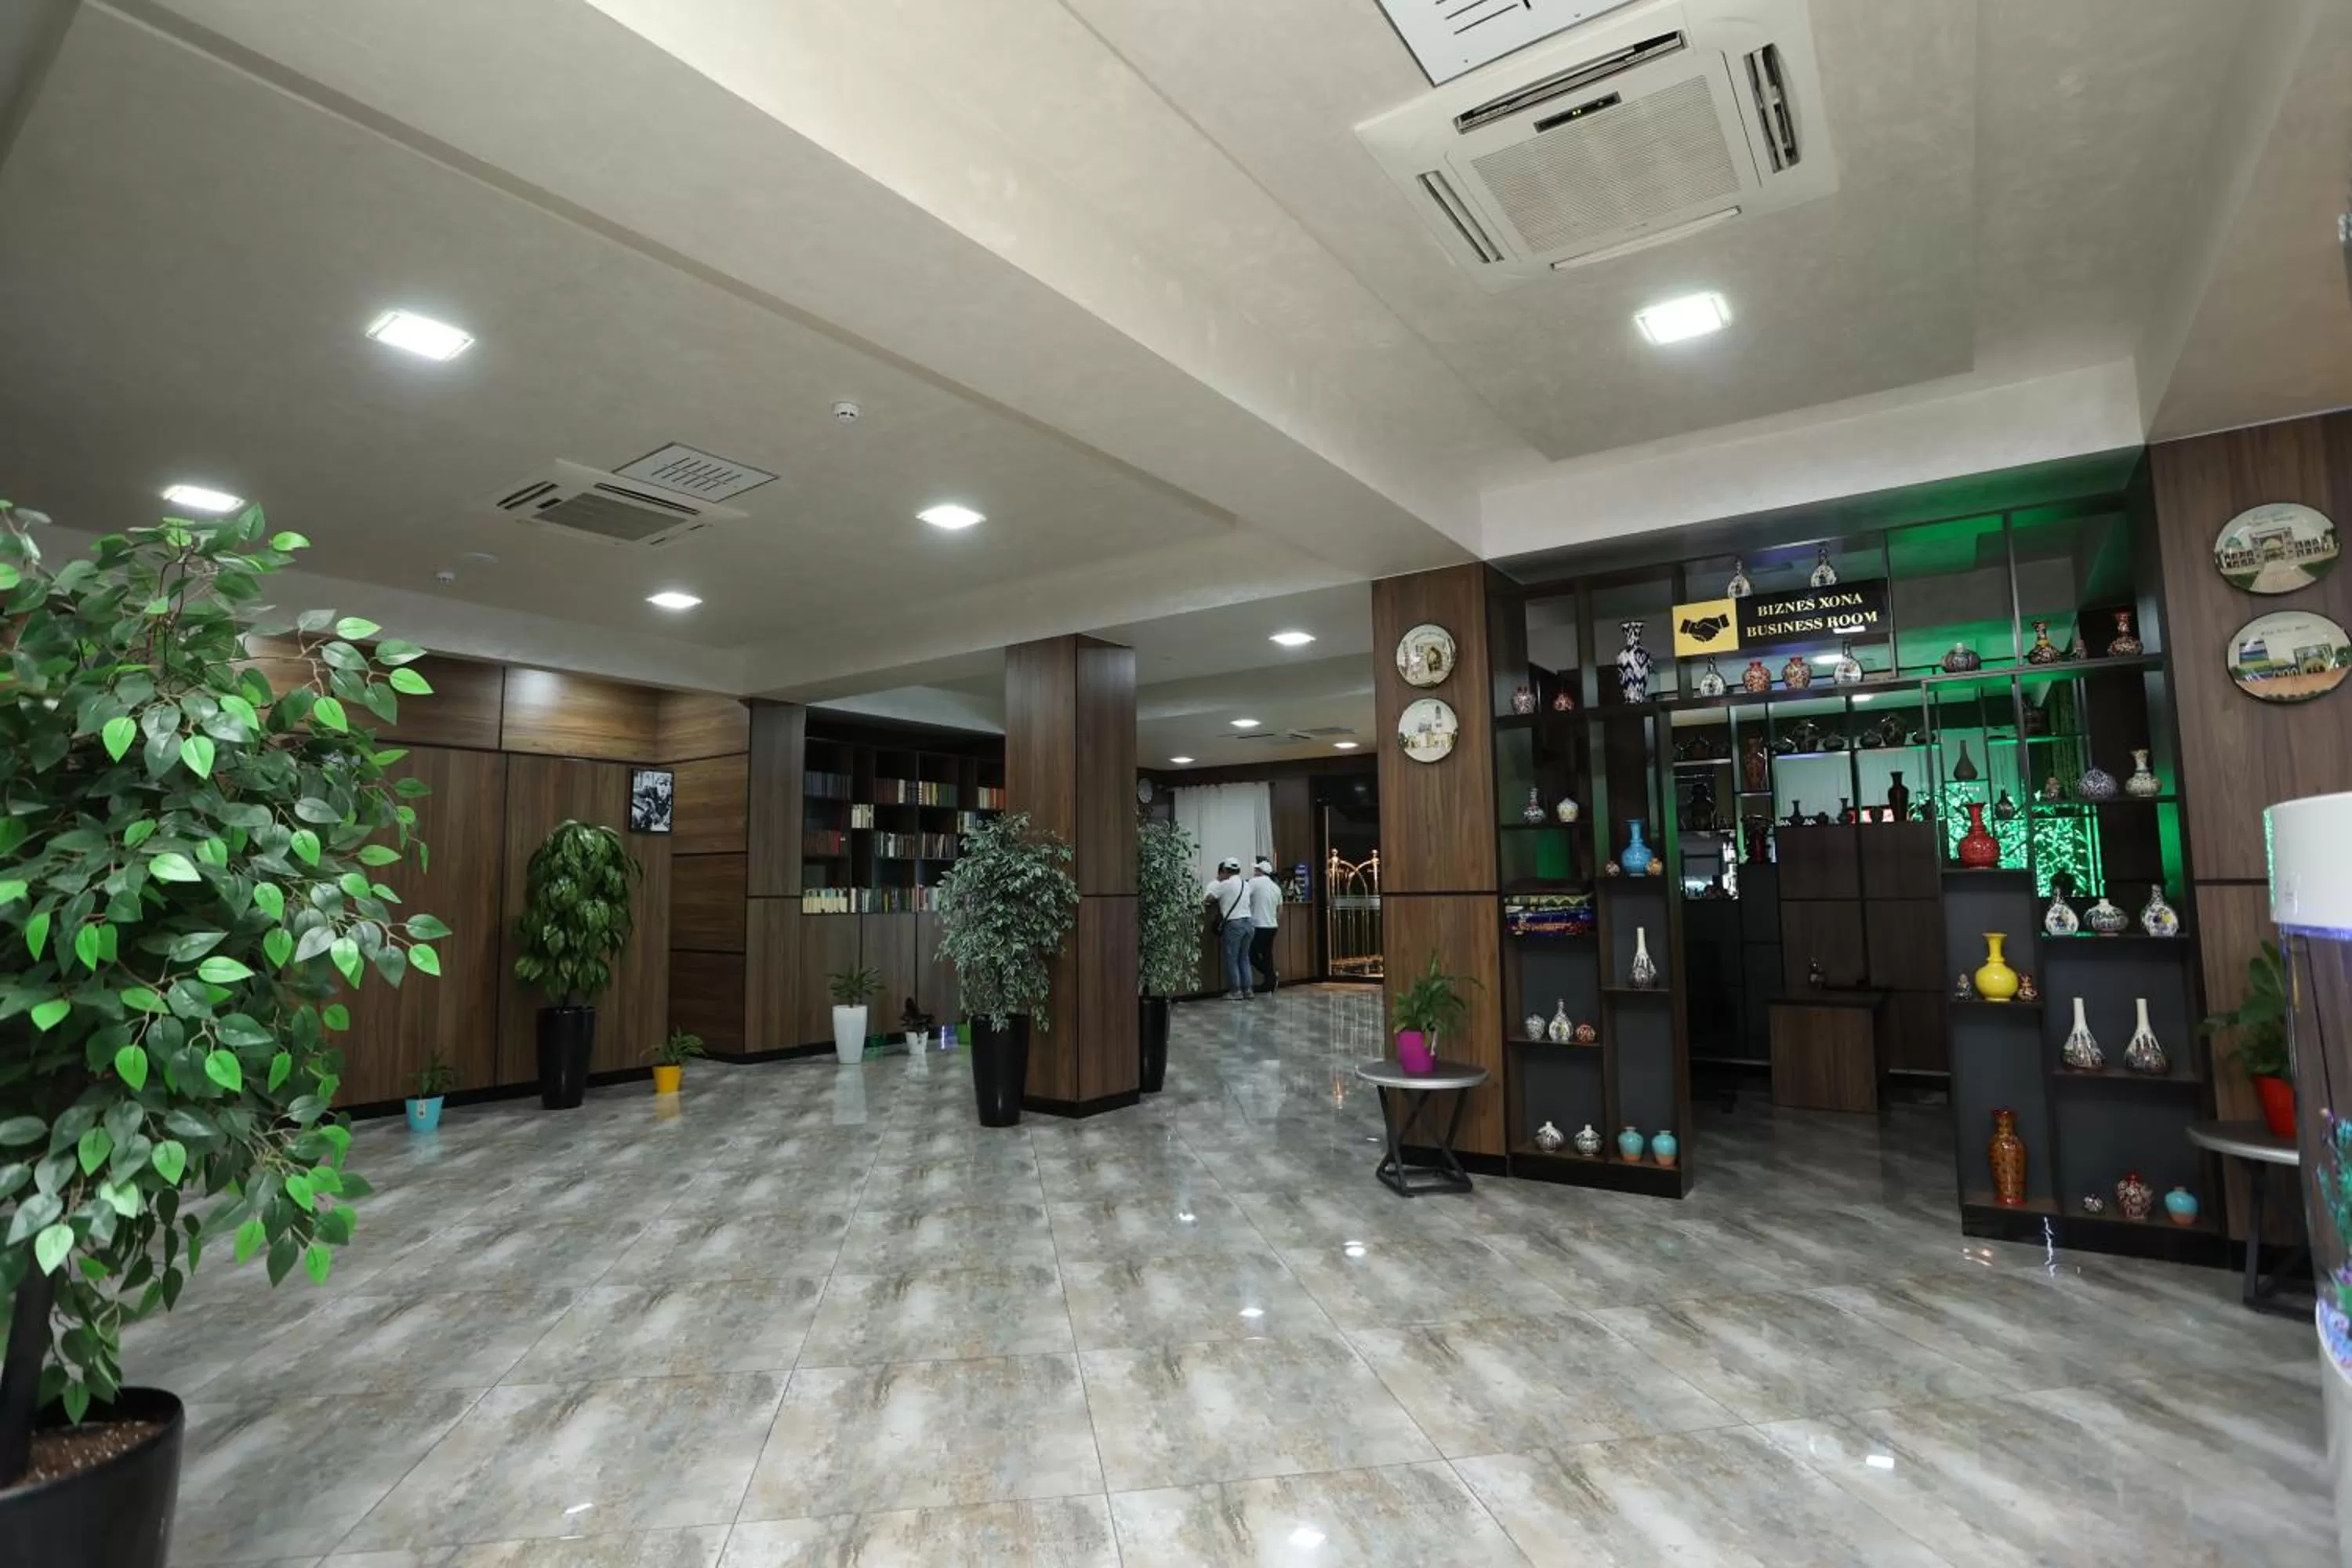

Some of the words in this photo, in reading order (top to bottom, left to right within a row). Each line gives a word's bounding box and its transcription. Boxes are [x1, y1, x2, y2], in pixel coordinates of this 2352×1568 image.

[1758, 598, 1815, 617] BIZNES
[1819, 593, 1864, 609] XONA
[1747, 617, 1824, 637] BUSINESS
[1828, 611, 1878, 628] ROOM
